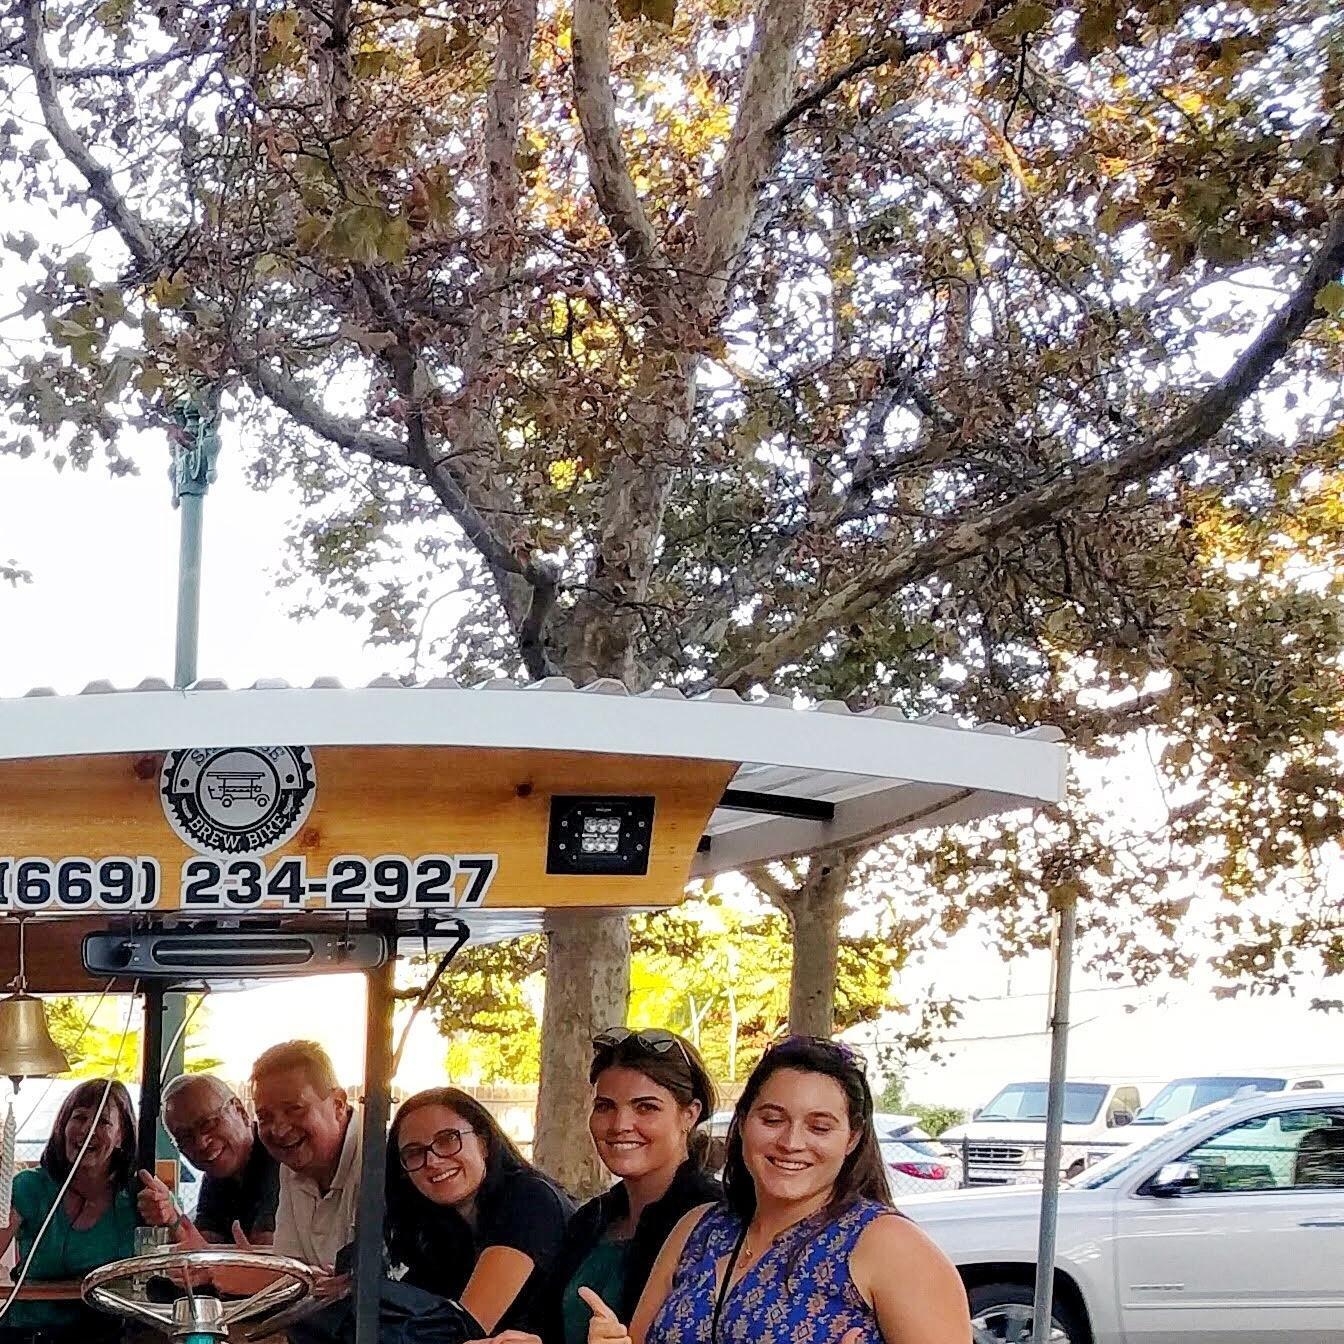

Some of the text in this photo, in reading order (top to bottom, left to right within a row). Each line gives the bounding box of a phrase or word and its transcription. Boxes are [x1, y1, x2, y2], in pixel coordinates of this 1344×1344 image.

[189, 813, 287, 849] BREW BIKE
[181, 854, 498, 907] 234-2927
